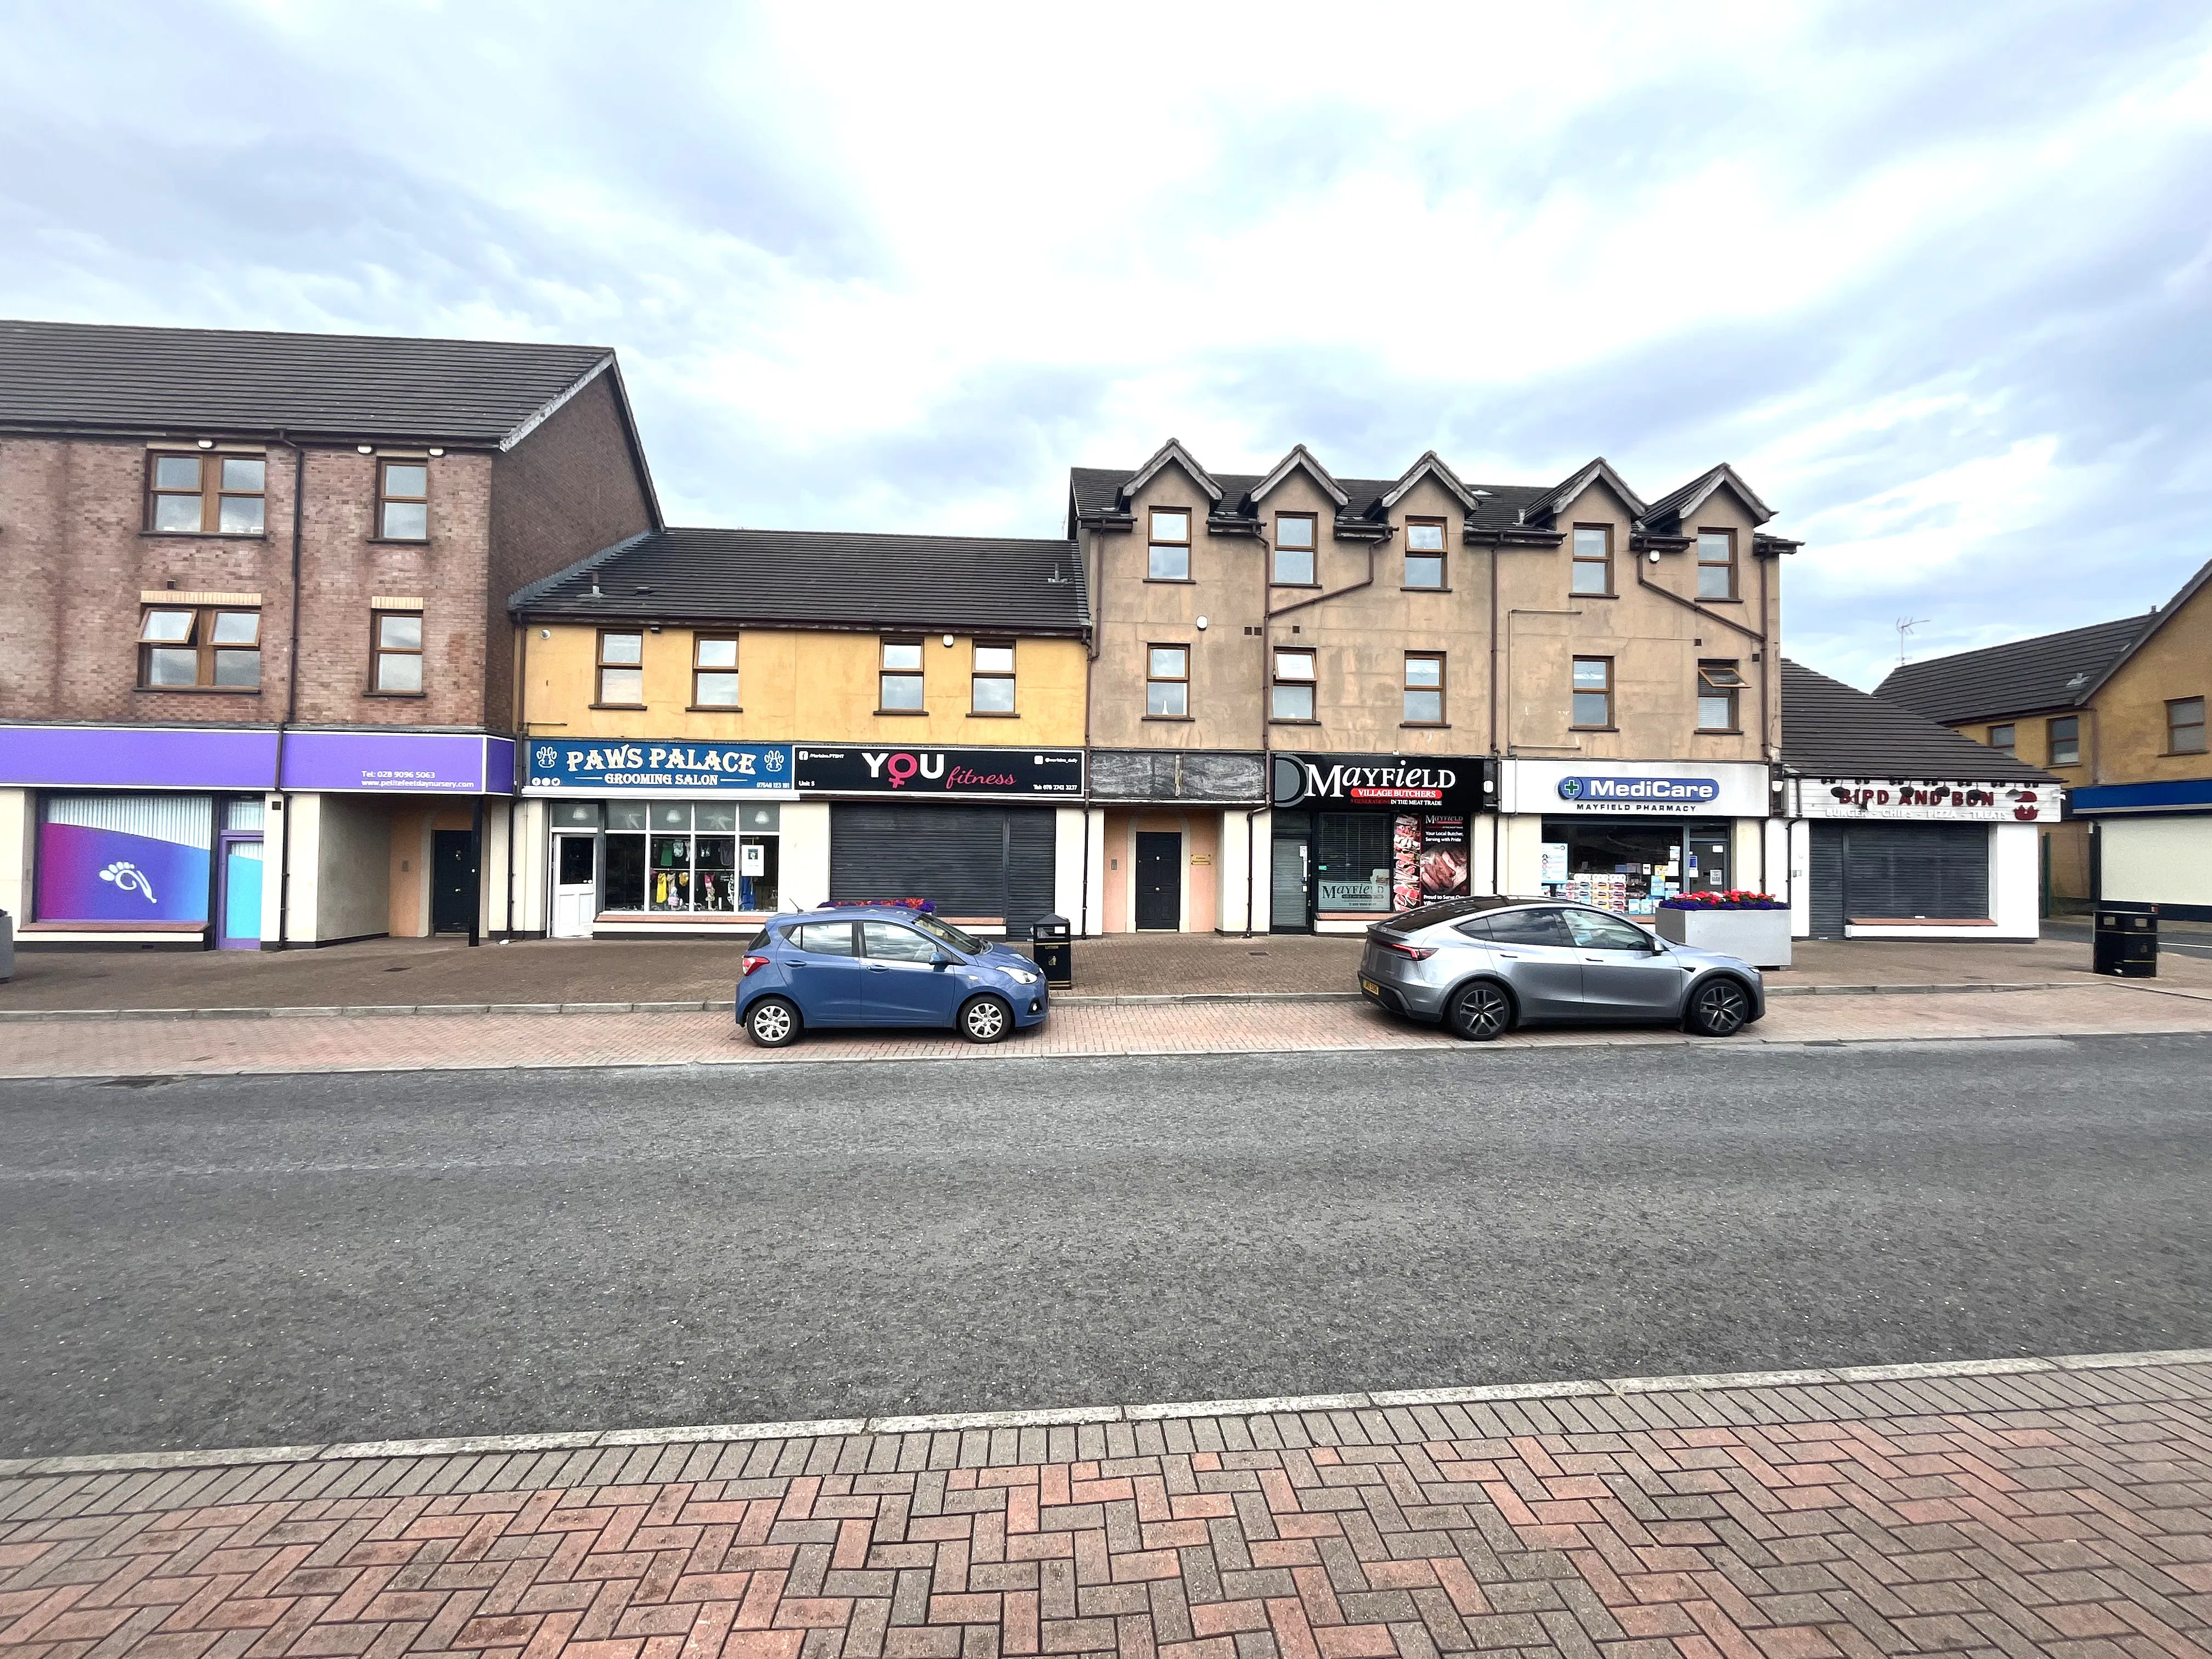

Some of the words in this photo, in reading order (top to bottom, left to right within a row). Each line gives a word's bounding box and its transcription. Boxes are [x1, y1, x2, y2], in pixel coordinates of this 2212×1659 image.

[650, 748, 757, 775] PALACE
[861, 753, 945, 789] YOU
[946, 766, 1017, 789] fitness
[361, 779, 475, 788] www.petitefeetdaynursery.com
[604, 773, 673, 785] GROOMING
[674, 774, 719, 786] SALON
[1358, 789, 1393, 797] VILLAGE
[1590, 780, 1714, 798] MediCare
[1882, 809, 1914, 818] CHIPS
[1927, 810, 1957, 819] PIZZA
[1971, 810, 2008, 820] TREATS
